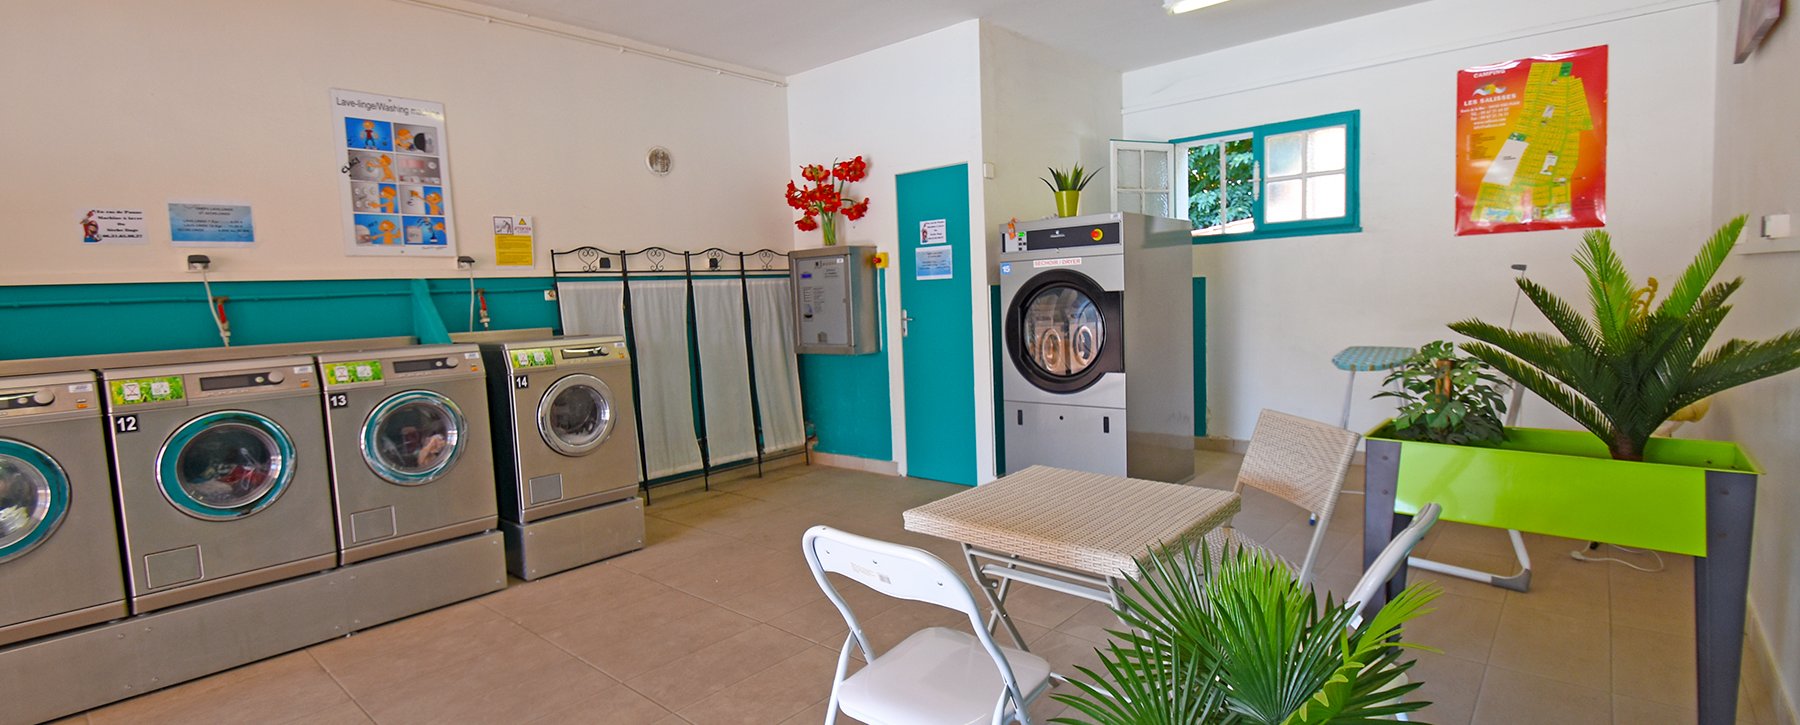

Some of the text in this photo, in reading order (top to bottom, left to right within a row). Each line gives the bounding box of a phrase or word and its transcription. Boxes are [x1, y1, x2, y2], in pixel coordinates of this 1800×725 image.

[1473, 69, 1506, 79] CAMPING
[1463, 99, 1478, 107] LES
[1479, 93, 1516, 104] SALISSES
[1002, 265, 1011, 273] 15
[516, 376, 528, 388] 14
[330, 395, 347, 407] 13
[117, 416, 137, 432] 12
